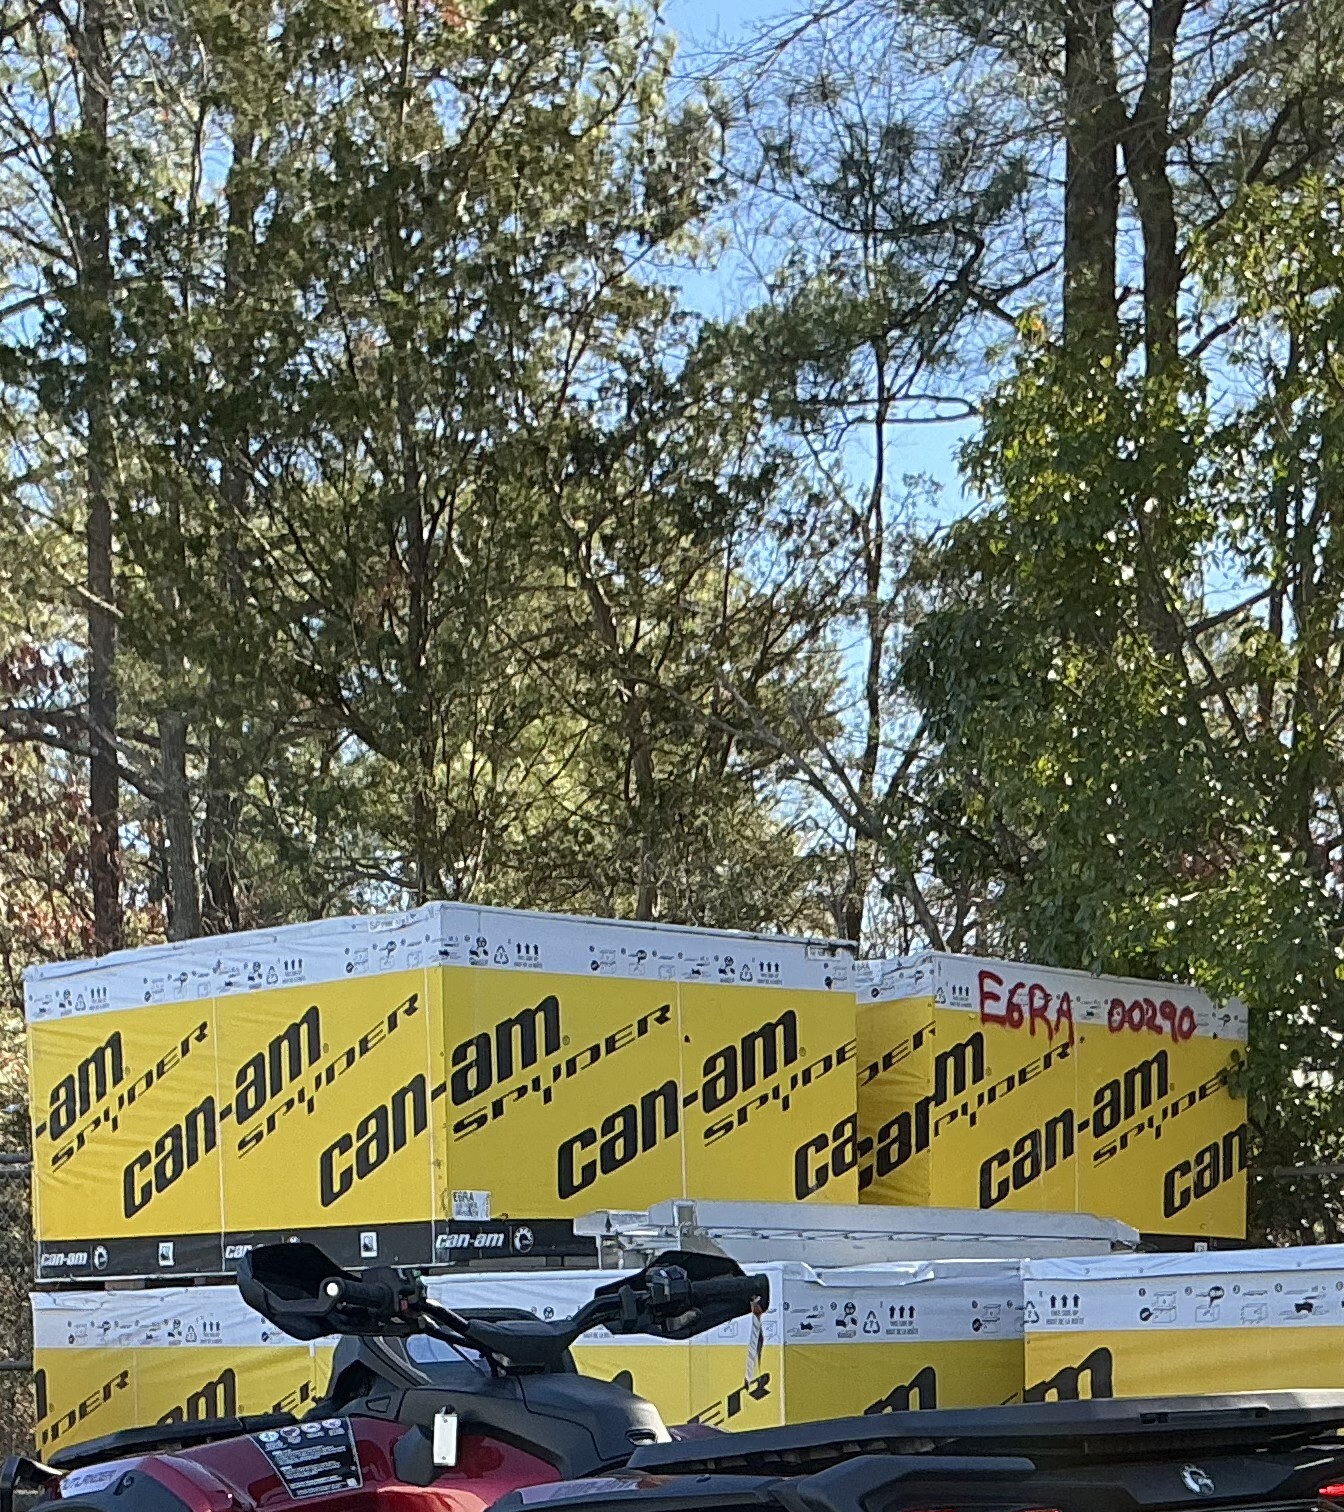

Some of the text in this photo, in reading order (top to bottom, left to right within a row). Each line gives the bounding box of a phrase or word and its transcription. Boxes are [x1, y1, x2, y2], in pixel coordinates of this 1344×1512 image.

[237, 993, 419, 1160] SPYDER
[453, 1004, 671, 1142] SPYDER
[979, 969, 1197, 1046] E6RA 00290
[52, 1020, 208, 1173] SPYDER
[124, 1006, 320, 1219] can-am
[320, 994, 560, 1208] can-am
[557, 1009, 798, 1200] can-am
[979, 1049, 1168, 1210] can-am
[41, 1252, 88, 1267] can-am
[436, 1233, 505, 1249] can-am
